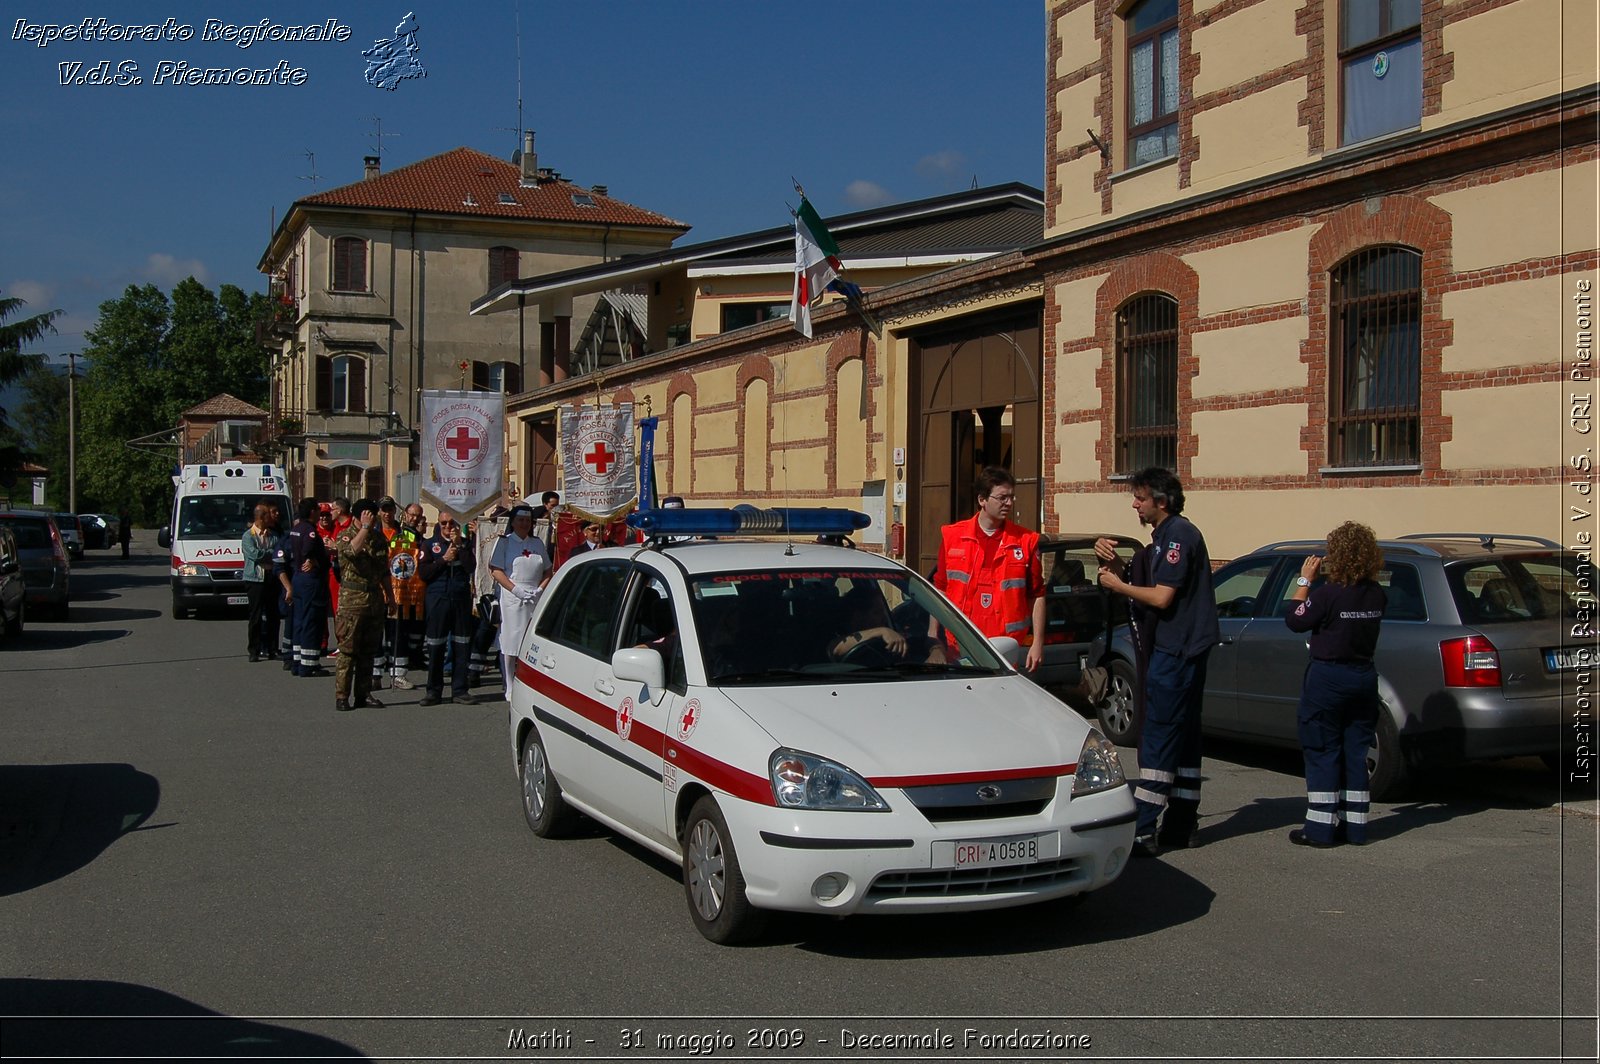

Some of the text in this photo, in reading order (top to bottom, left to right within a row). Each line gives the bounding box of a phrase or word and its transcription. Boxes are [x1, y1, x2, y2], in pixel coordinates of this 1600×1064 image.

[712, 572, 905, 582] CROCE ROSSA ITALIANA
[957, 845, 980, 863] CRI
